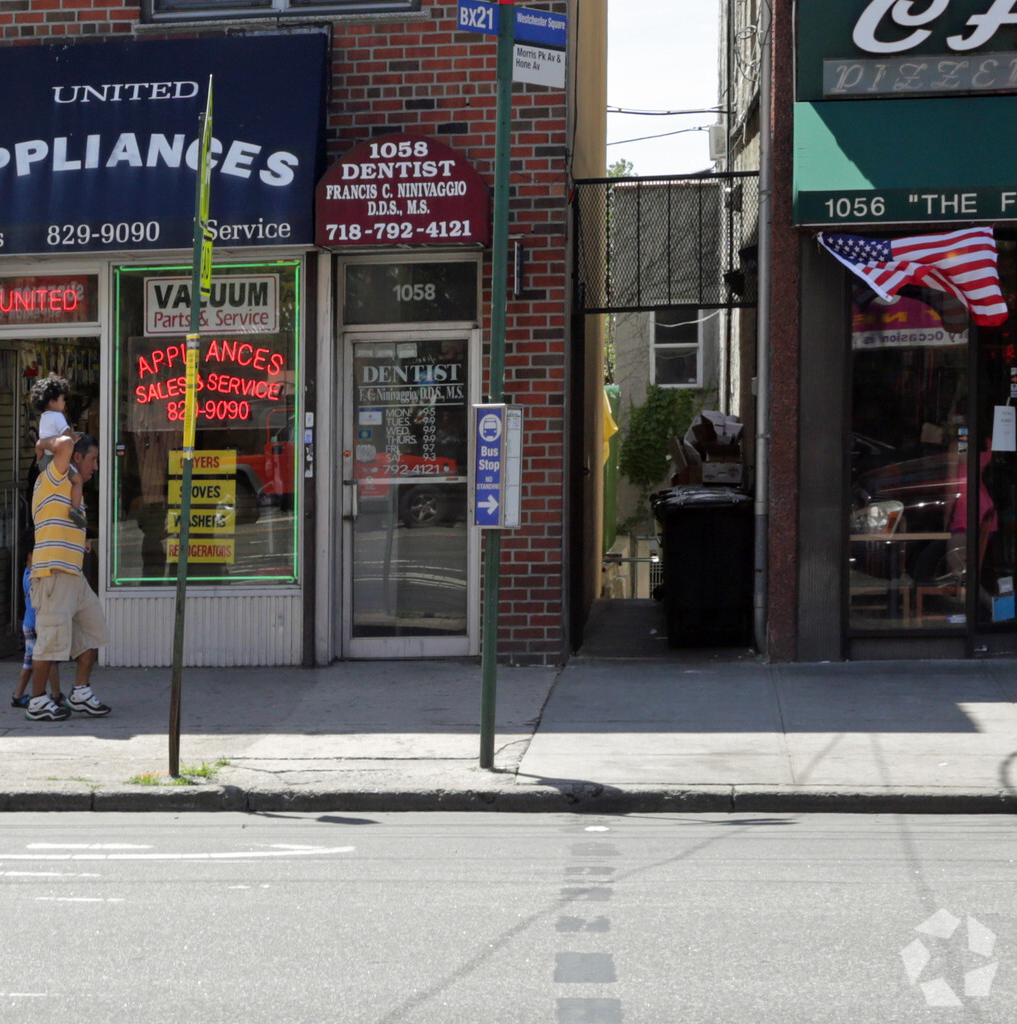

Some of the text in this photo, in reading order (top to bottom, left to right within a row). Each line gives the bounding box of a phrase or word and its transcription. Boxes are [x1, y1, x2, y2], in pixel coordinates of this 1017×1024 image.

[460, 6, 493, 29] BX21
[517, 12, 565, 31] Westchester Square
[517, 47, 562, 63] Morris Pk Av &
[515, 59, 541, 72] Hone Av
[51, 80, 199, 104] UNITED
[369, 141, 429, 159] 1058
[341, 160, 456, 180] DENTIST
[325, 180, 467, 200] FRANCIS C. NINIVAGGIO
[367, 199, 430, 217] D.D.S., M.S.
[824, 196, 885, 218] 1056
[46, 221, 161, 246] 829-9090
[206, 217, 292, 242] Service
[325, 219, 472, 241] 718-792-4121
[153, 282, 269, 309] VAUUM
[393, 284, 436, 302] 1058
[153, 310, 190, 329] Parts
[215, 309, 269, 327] Service
[137, 339, 286, 379] APPLANCES
[362, 363, 462, 384] DENTIST
[206, 372, 283, 402] SERVICE
[446, 386, 464, 400] M.S.
[166, 400, 251, 421] 82-9090
[480, 446, 499, 457] Bus
[383, 464, 440, 475] 792-4121
[479, 459, 501, 472] Stop
